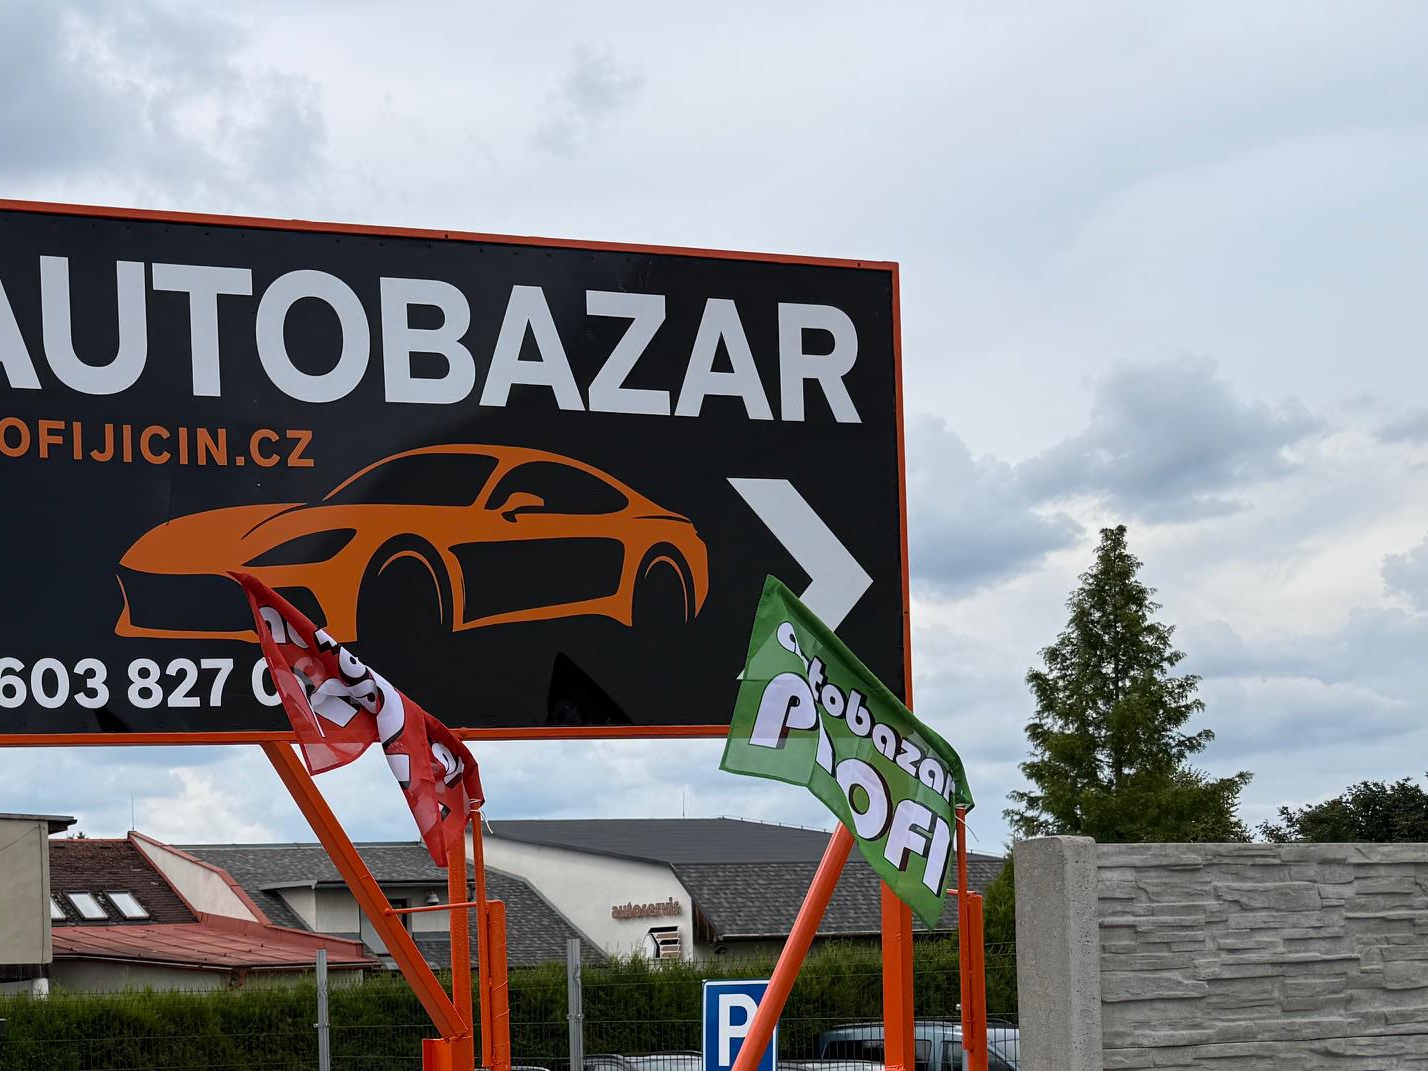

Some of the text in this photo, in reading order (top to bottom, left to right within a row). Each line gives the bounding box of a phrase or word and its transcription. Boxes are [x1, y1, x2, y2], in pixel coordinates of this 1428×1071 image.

[128, 658, 233, 708] 827
[776, 621, 956, 804] atobazar
[749, 671, 952, 898] POFI
[611, 896, 680, 919] autoservis
[718, 993, 758, 1067] P
